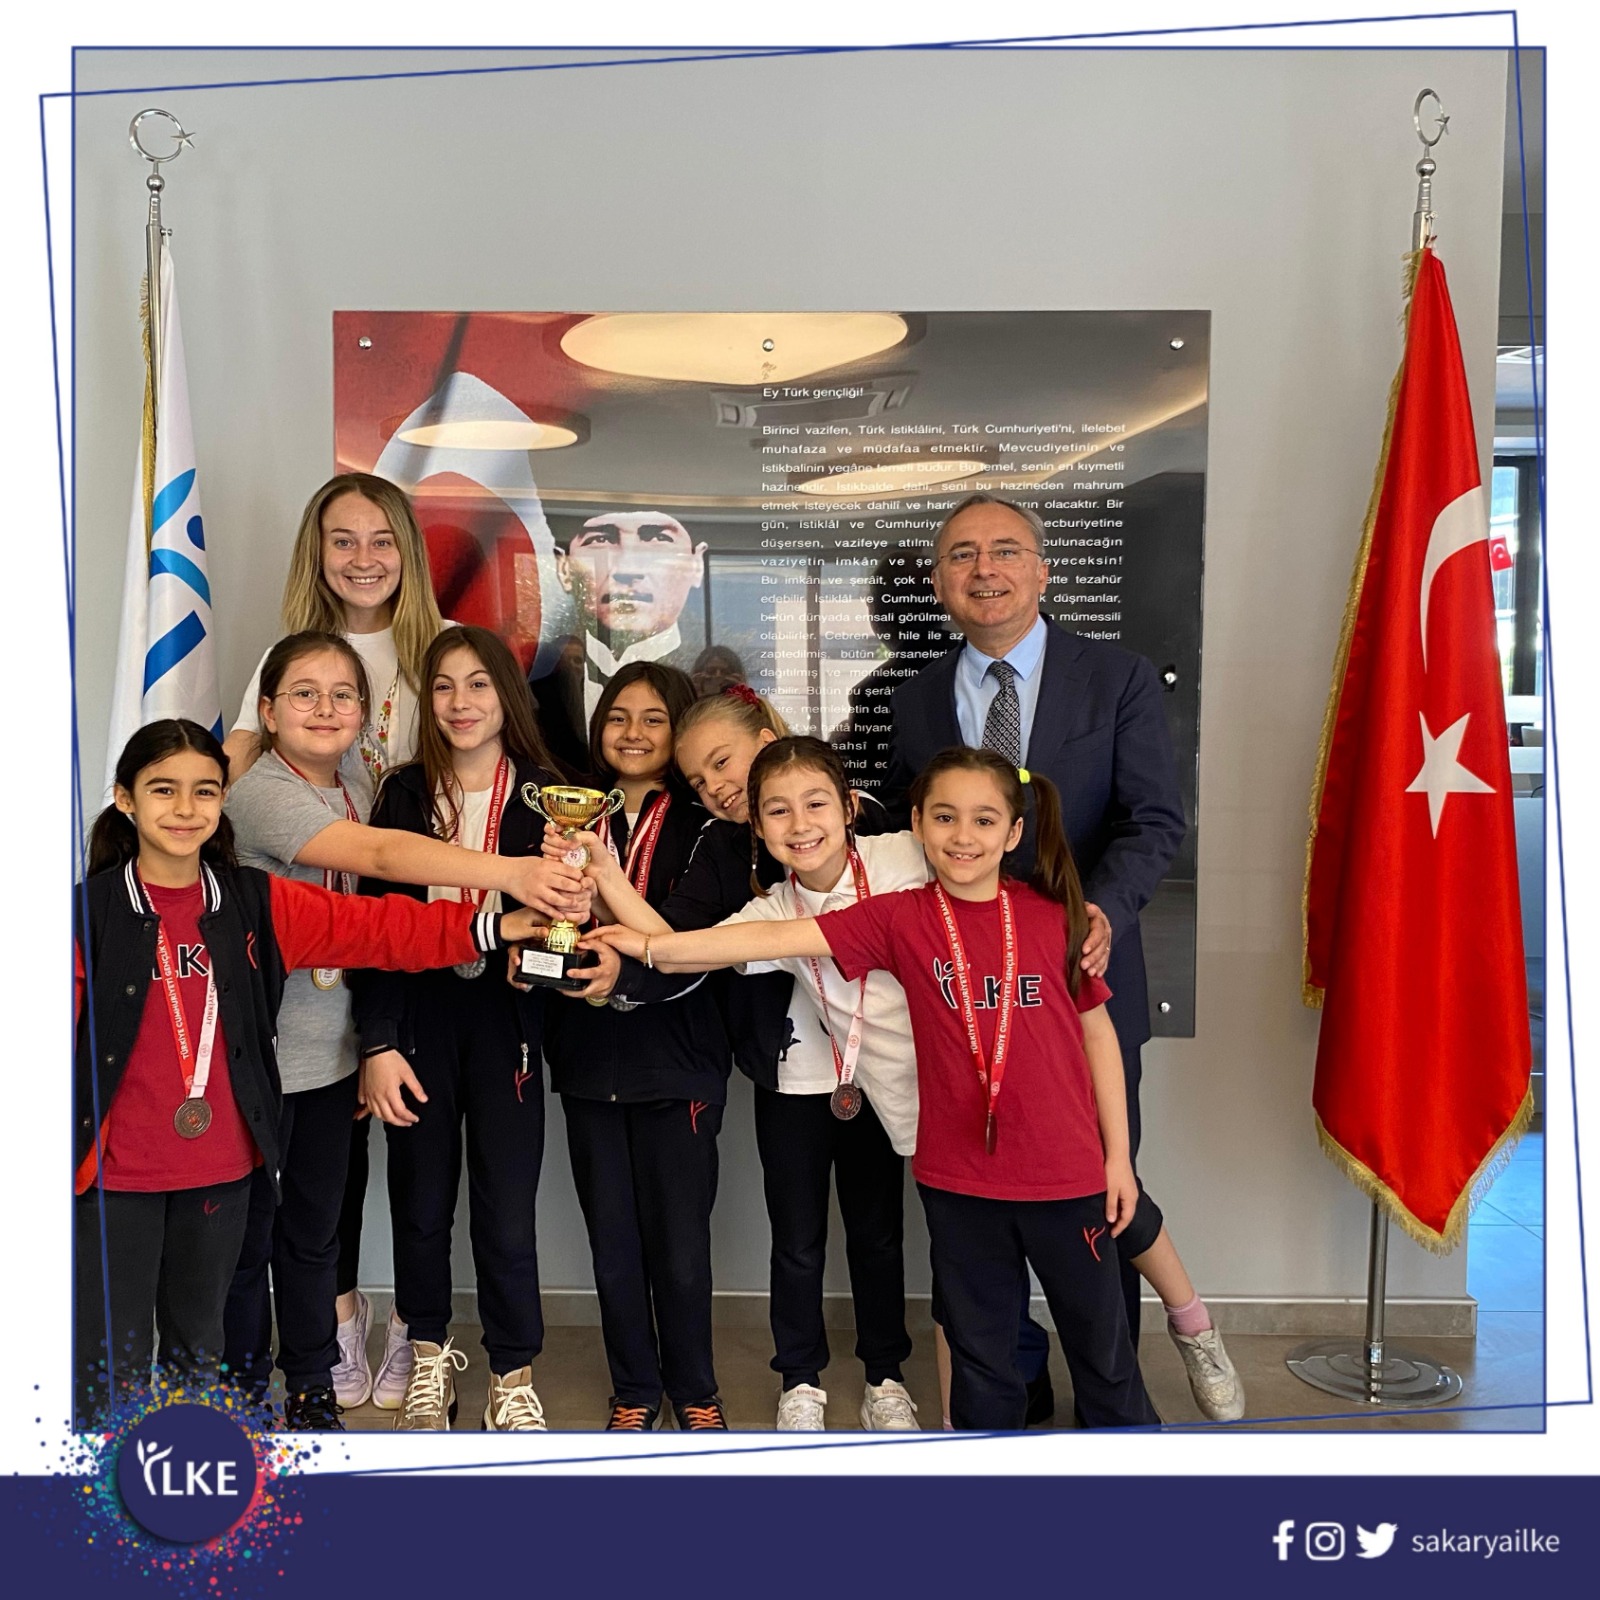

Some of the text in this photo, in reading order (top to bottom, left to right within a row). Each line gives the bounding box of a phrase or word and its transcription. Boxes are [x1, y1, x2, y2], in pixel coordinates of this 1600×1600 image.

[763, 387, 864, 400] Ey Türk gençliği!
[762, 424, 1126, 436] Birinci vazifen, Türk istiklâlini, Türk Cumhuriyeti'ni, ilelebet
[762, 443, 1125, 454] muhafaza ve müdafaa etmektir. Mevcudiyetinin ve
[762, 464, 824, 473] istikbalinin
[828, 463, 873, 474] yegâne
[876, 463, 913, 472] temeli
[918, 463, 954, 472] budur.
[960, 462, 976, 472] Bu
[980, 462, 1017, 472] temel,
[1022, 462, 1056, 471] senin
[1078, 462, 1124, 472] kıymetli
[762, 481, 1124, 492] hazinendir. İstikbalde dahi, seni bu hazineden mahrum
[762, 502, 798, 510] etmek
[804, 502, 861, 512] isteyecek
[867, 500, 901, 510] dahilî
[906, 502, 921, 510] ve
[927, 501, 957, 510] haric
[1044, 500, 1100, 509] olacaktır.
[1106, 500, 1124, 509] Bir
[762, 519, 1123, 531] gün, istiklâl ve Cumhuriye ecburiyetine
[761, 538, 824, 549] düşersen,
[834, 538, 888, 549] vazifeye
[761, 557, 825, 568] vaziyetin
[836, 556, 878, 566] imkân
[889, 558, 905, 566] ve
[1044, 556, 1122, 568] eyeceksin!
[761, 576, 777, 584] Bu
[785, 576, 820, 585] imkân
[850, 575, 886, 586] şerâit,
[894, 576, 916, 586] çok
[1075, 575, 1122, 584] tezahür
[760, 594, 806, 604] edebilir.
[815, 592, 851, 603] İstiklâl
[881, 594, 938, 605] Cumhuriy
[760, 613, 794, 622] bütün
[798, 613, 850, 624] dünyada
[855, 612, 894, 622] emsali
[898, 613, 951, 624] görülme
[1060, 612, 1121, 621] mümessili
[760, 632, 816, 640] olabilirler.
[825, 631, 868, 640] Cebren
[899, 631, 920, 640] hile
[928, 631, 942, 640] ile
[950, 632, 964, 640] az
[841, 649, 874, 659] bütün
[760, 668, 818, 678] dağıtılmış
[850, 668, 918, 677] memleketin
[760, 687, 801, 696] olabilir.
[808, 686, 841, 696] Bütün
[846, 687, 860, 696] bu
[801, 705, 870, 714] memleketin
[822, 723, 850, 732] hattâ
[854, 723, 892, 734] hıyane
[849, 778, 881, 788] düşm
[177, 1028, 189, 1060] TÜRKİYE
